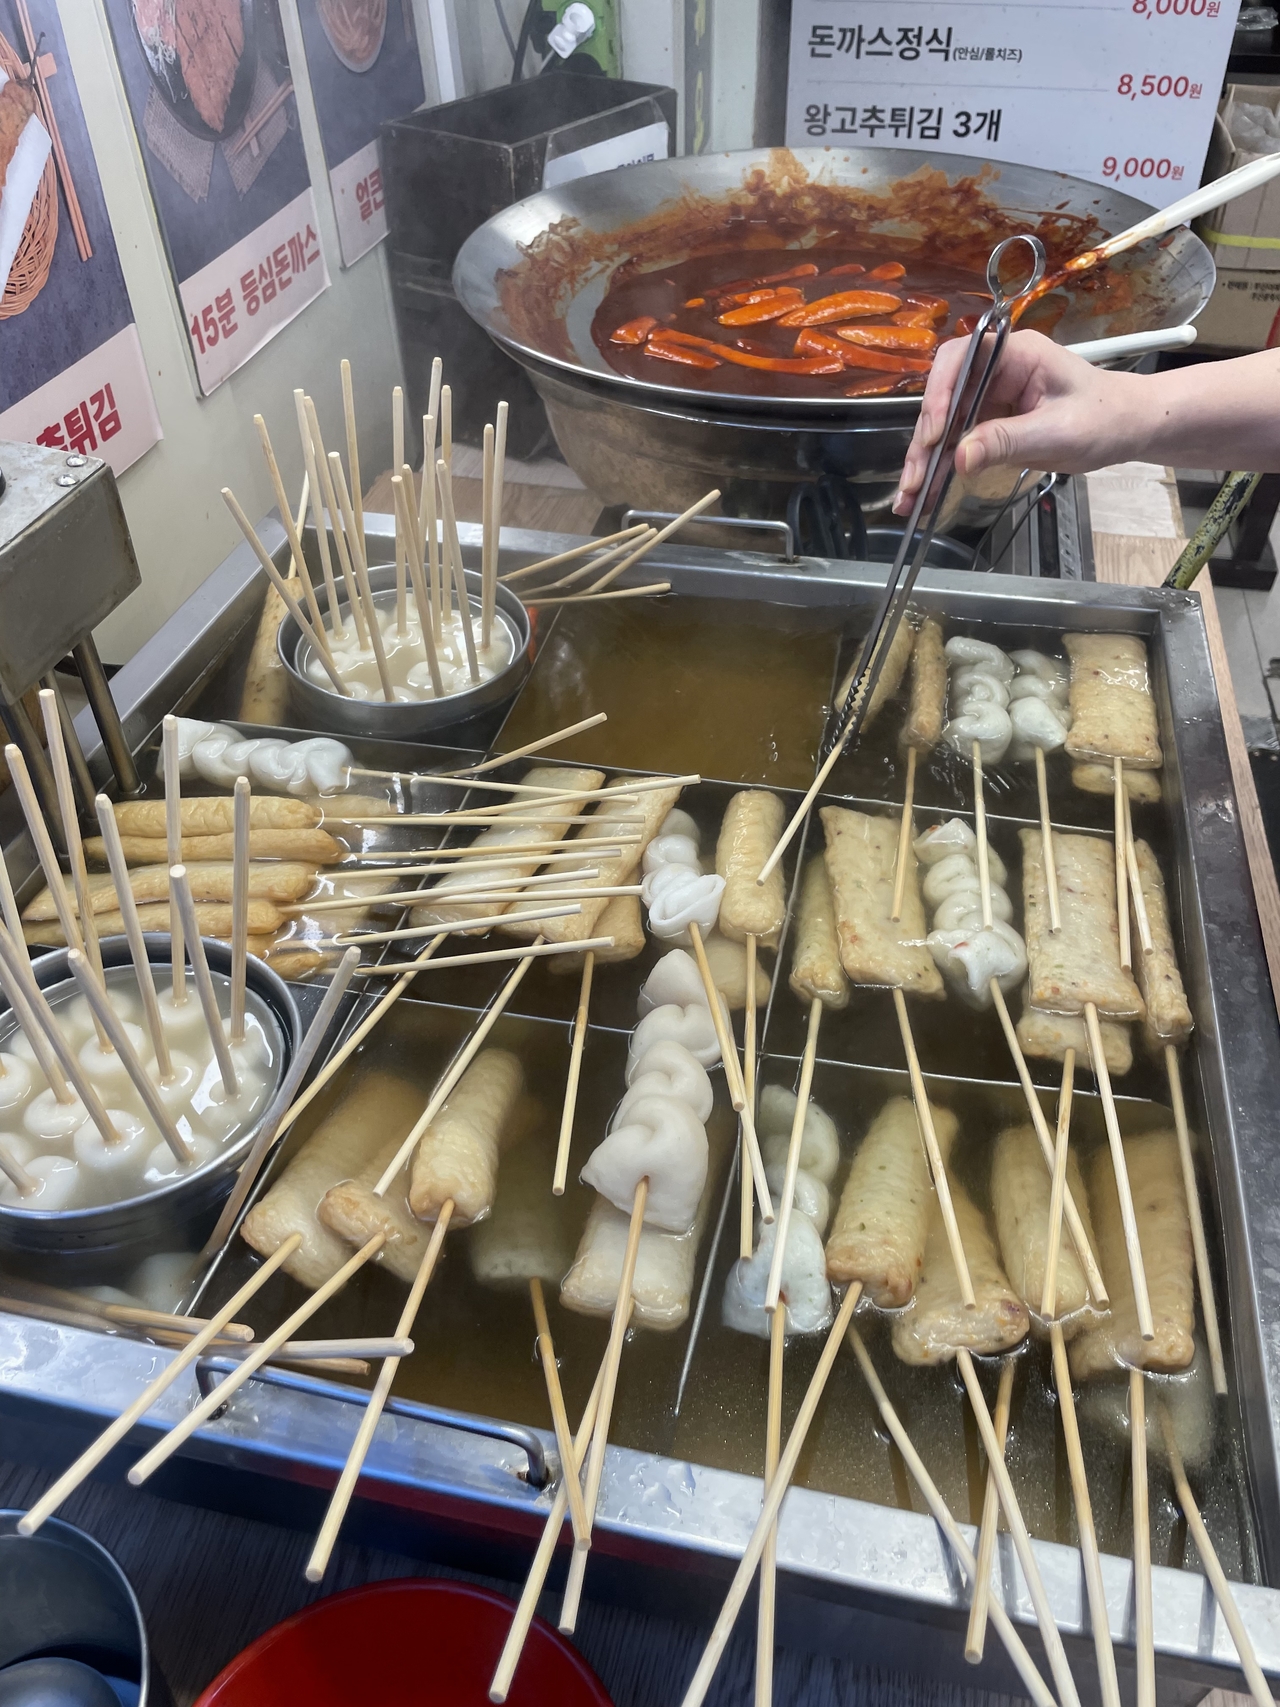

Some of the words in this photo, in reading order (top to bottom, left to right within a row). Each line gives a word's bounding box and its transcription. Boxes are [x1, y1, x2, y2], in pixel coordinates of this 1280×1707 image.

[1132, 0, 1221, 20] 8,000원
[1117, 73, 1203, 101] 8,500원
[804, 103, 943, 140] 왕고추튀김
[952, 108, 1002, 141] 3개
[1102, 156, 1185, 182] 9,000원
[191, 287, 239, 354] 15분
[240, 224, 320, 316] 등심돈까스
[36, 382, 122, 456] 추튀김
